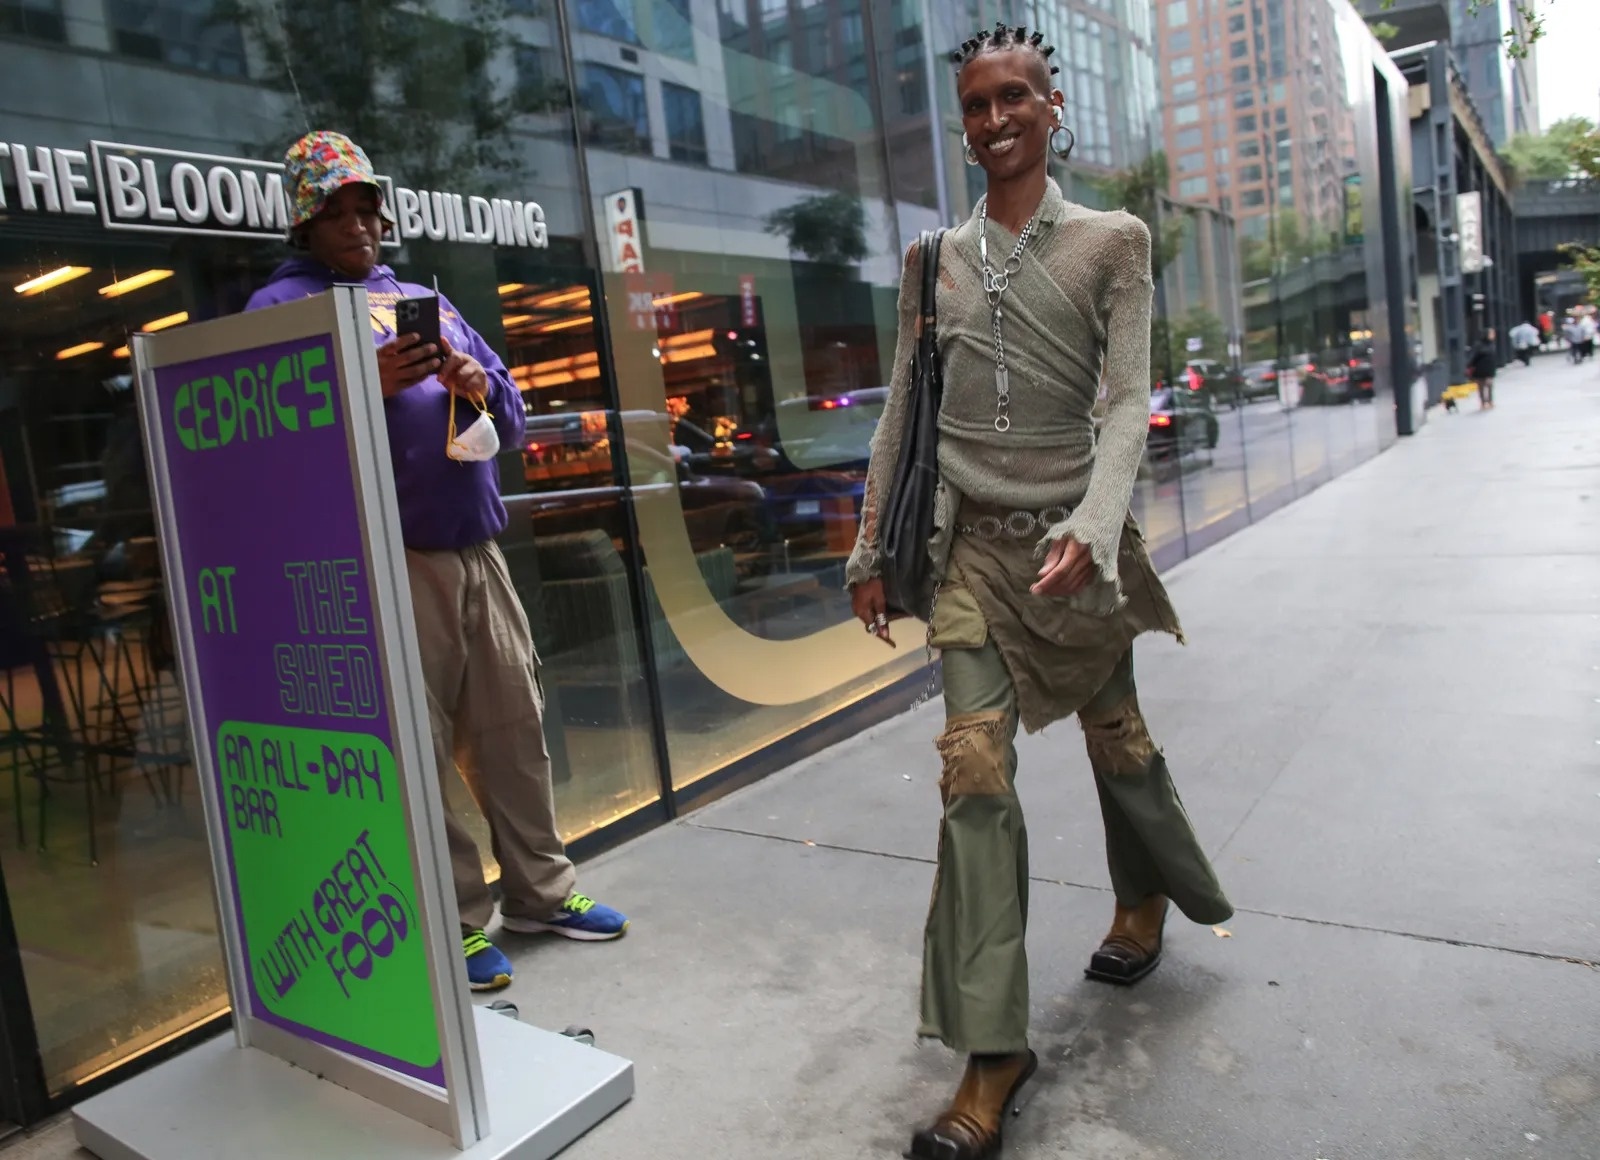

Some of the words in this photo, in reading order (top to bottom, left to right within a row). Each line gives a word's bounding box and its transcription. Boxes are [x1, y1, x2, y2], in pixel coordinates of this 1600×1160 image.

[395, 187, 548, 249] BUILDING
[199, 566, 238, 634] AT
[284, 558, 367, 635] THE
[274, 643, 380, 719] SHED
[224, 734, 257, 783] AN
[261, 738, 384, 802] ALL-DAY
[231, 783, 282, 838] BAR
[313, 829, 387, 935] GREAT
